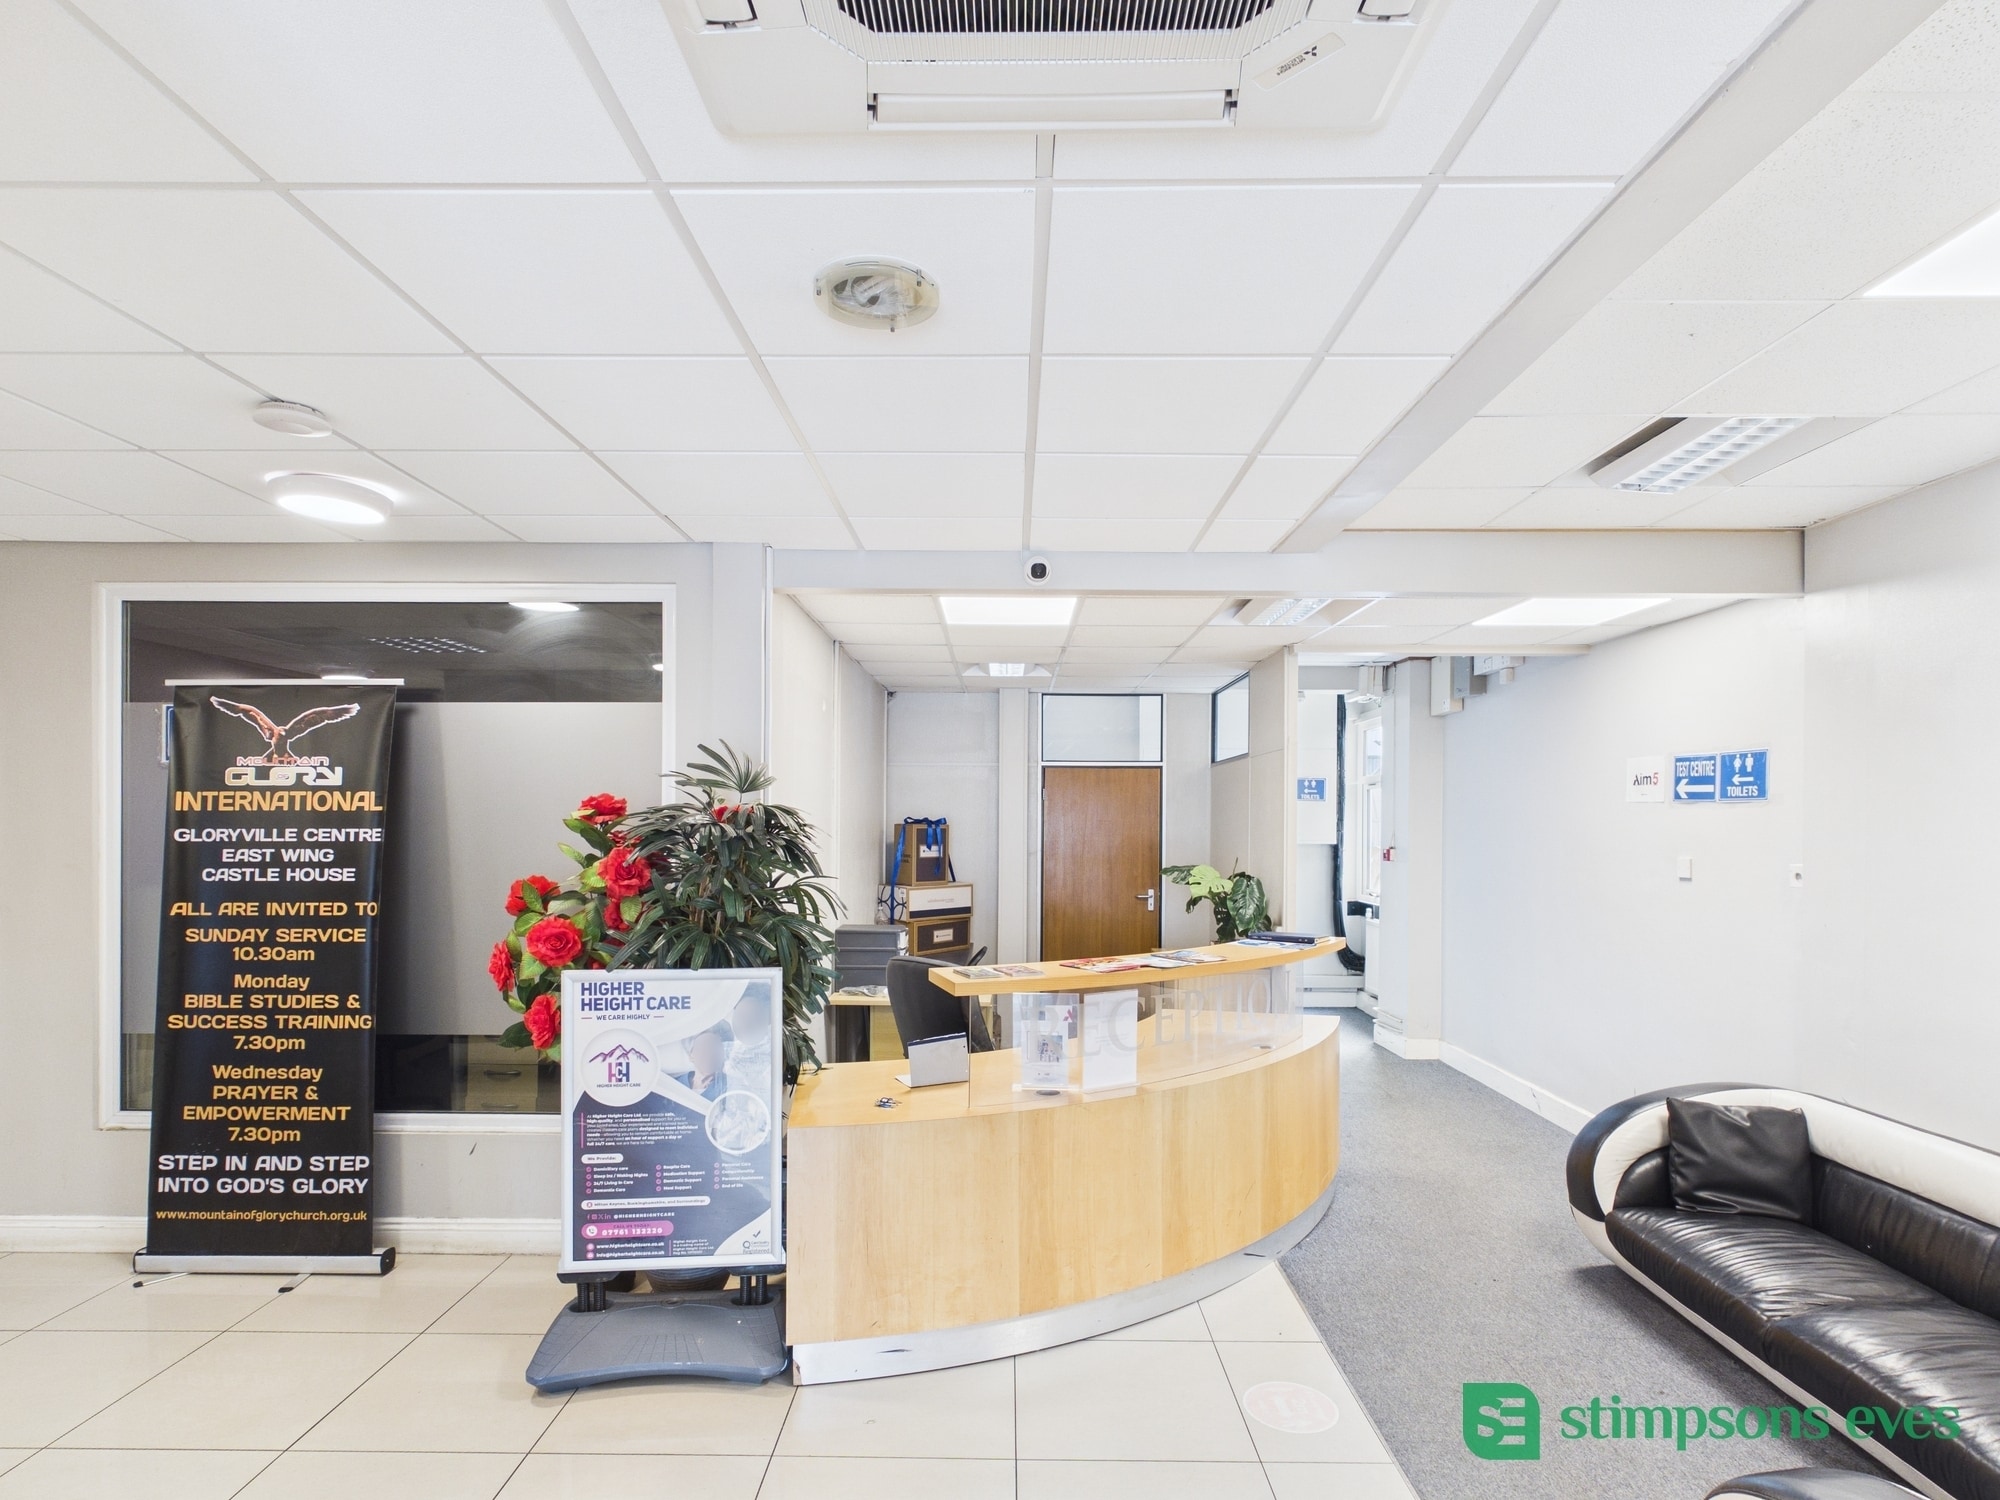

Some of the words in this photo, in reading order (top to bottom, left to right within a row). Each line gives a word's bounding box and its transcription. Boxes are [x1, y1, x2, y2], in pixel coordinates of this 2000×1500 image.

[237, 757, 329, 766] MOUNTAIN
[1676, 762, 1690, 777] TEST
[1691, 760, 1714, 776] CENTRE
[225, 767, 342, 786] GLORY
[1726, 786, 1758, 796] TOILETS
[175, 791, 383, 812] INTERNATIONAL
[174, 828, 297, 842] GLORYVILLE
[304, 828, 382, 842] CENTRE
[222, 849, 274, 862] EAST
[281, 849, 334, 862] WING
[202, 868, 280, 882] CASTLE
[286, 868, 356, 882] HOUSE
[170, 902, 212, 916] ALL
[218, 902, 258, 916] ARE
[266, 902, 347, 916] INVITED
[355, 902, 377, 916] TO
[186, 928, 268, 942] SUNDAY
[276, 928, 366, 942] SERVICE
[233, 947, 314, 961] 10.30am
[234, 974, 310, 991] Monday
[580, 982, 644, 996] HIGHER
[184, 995, 242, 1008] BIBLE
[250, 995, 339, 1008] STUDIES
[347, 995, 360, 1008] &
[581, 997, 644, 1011] HEIGHT
[646, 996, 691, 1010] CARE
[168, 1015, 267, 1029] SUCCESS
[275, 1015, 372, 1029] TRAINING
[233, 1036, 306, 1052] 7.30pm
[212, 1065, 322, 1082] Wednesday
[213, 1086, 298, 1100] PRAYER
[305, 1086, 318, 1100] &
[183, 1106, 350, 1120] EMPOWERMENT
[228, 1128, 300, 1144] 7.30pm
[158, 1155, 218, 1170] STEP
[225, 1155, 247, 1170] IN
[255, 1156, 302, 1171] AND
[310, 1156, 370, 1172] STEP
[158, 1178, 209, 1193] INTO
[216, 1178, 284, 1194] GOD'S
[292, 1178, 368, 1194] GLORY
[156, 1210, 367, 1222] www.mountainofglorychurch.org.uk
